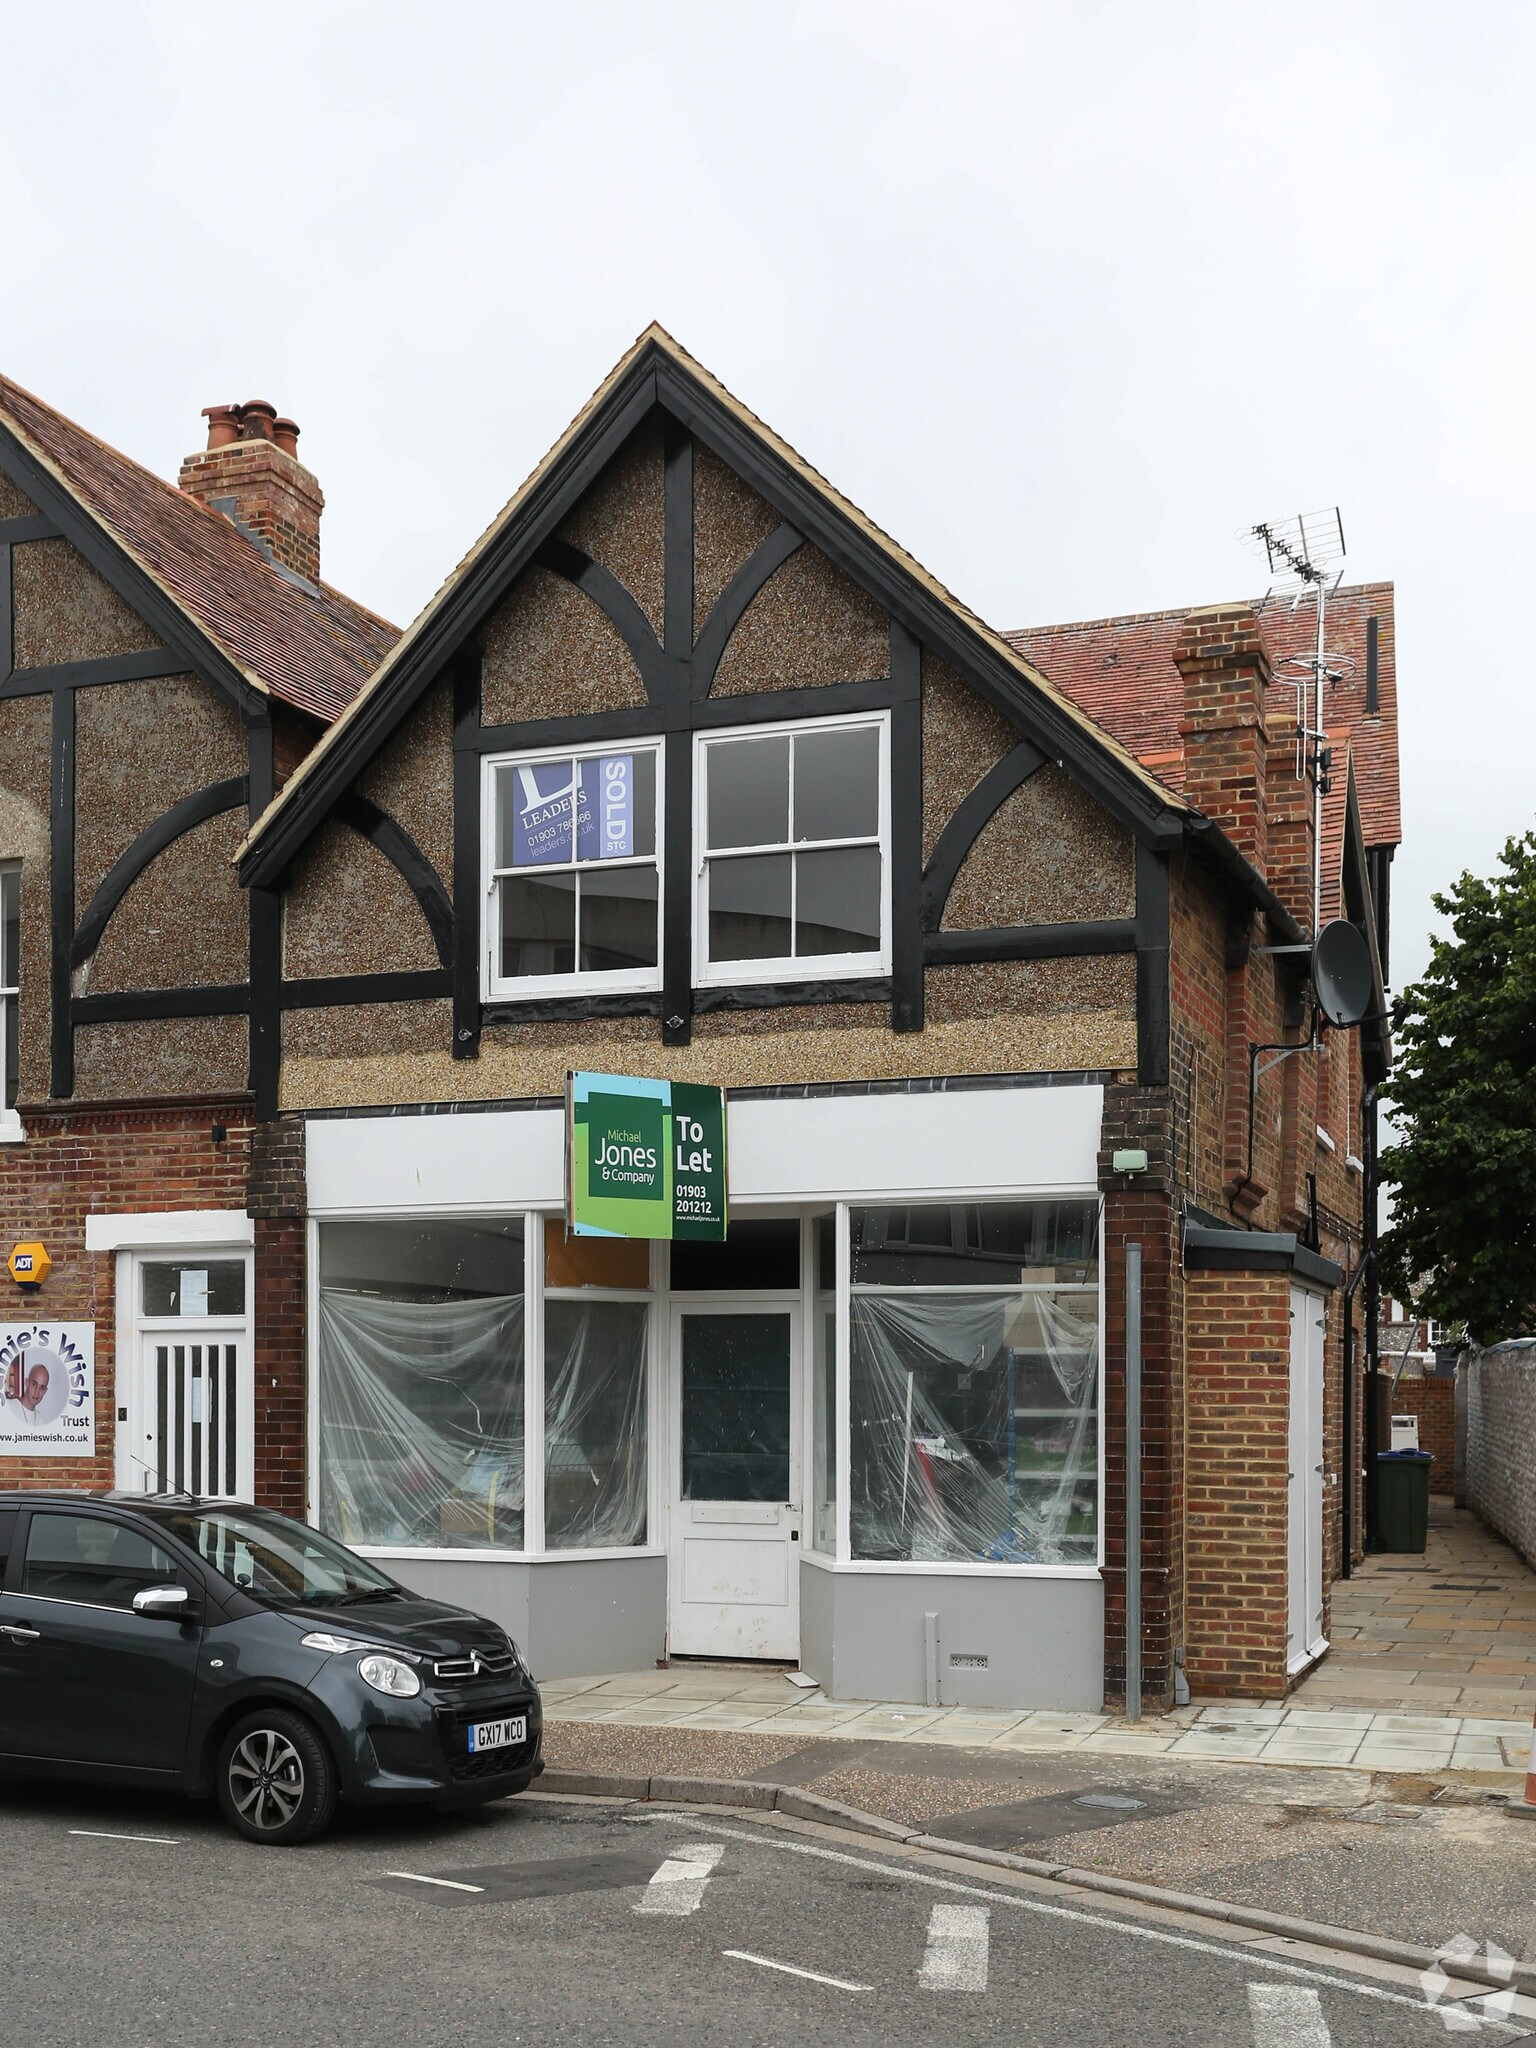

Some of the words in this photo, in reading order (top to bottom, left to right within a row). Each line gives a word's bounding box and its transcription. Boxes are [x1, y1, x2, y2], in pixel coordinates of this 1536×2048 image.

[605, 761, 627, 840] SOLD
[528, 827, 557, 847] 01903
[607, 840, 626, 852] STC
[607, 1129, 641, 1143] Michael
[676, 1115, 704, 1143] To
[594, 1137, 657, 1168] Jones
[676, 1145, 713, 1173] Let
[602, 1166, 611, 1180] &
[611, 1168, 655, 1186] Company
[676, 1185, 706, 1198] 01903
[676, 1199, 712, 1214] 201212
[15, 1257, 33, 1269] ADT
[0, 1326, 51, 1408] mie's
[58, 1331, 90, 1408] Wish
[60, 1415, 90, 1427] Trust
[0, 1433, 89, 1444] ww.jamieswish.co.uk
[479, 1724, 501, 1746] GX17
[504, 1720, 522, 1741] WCO
